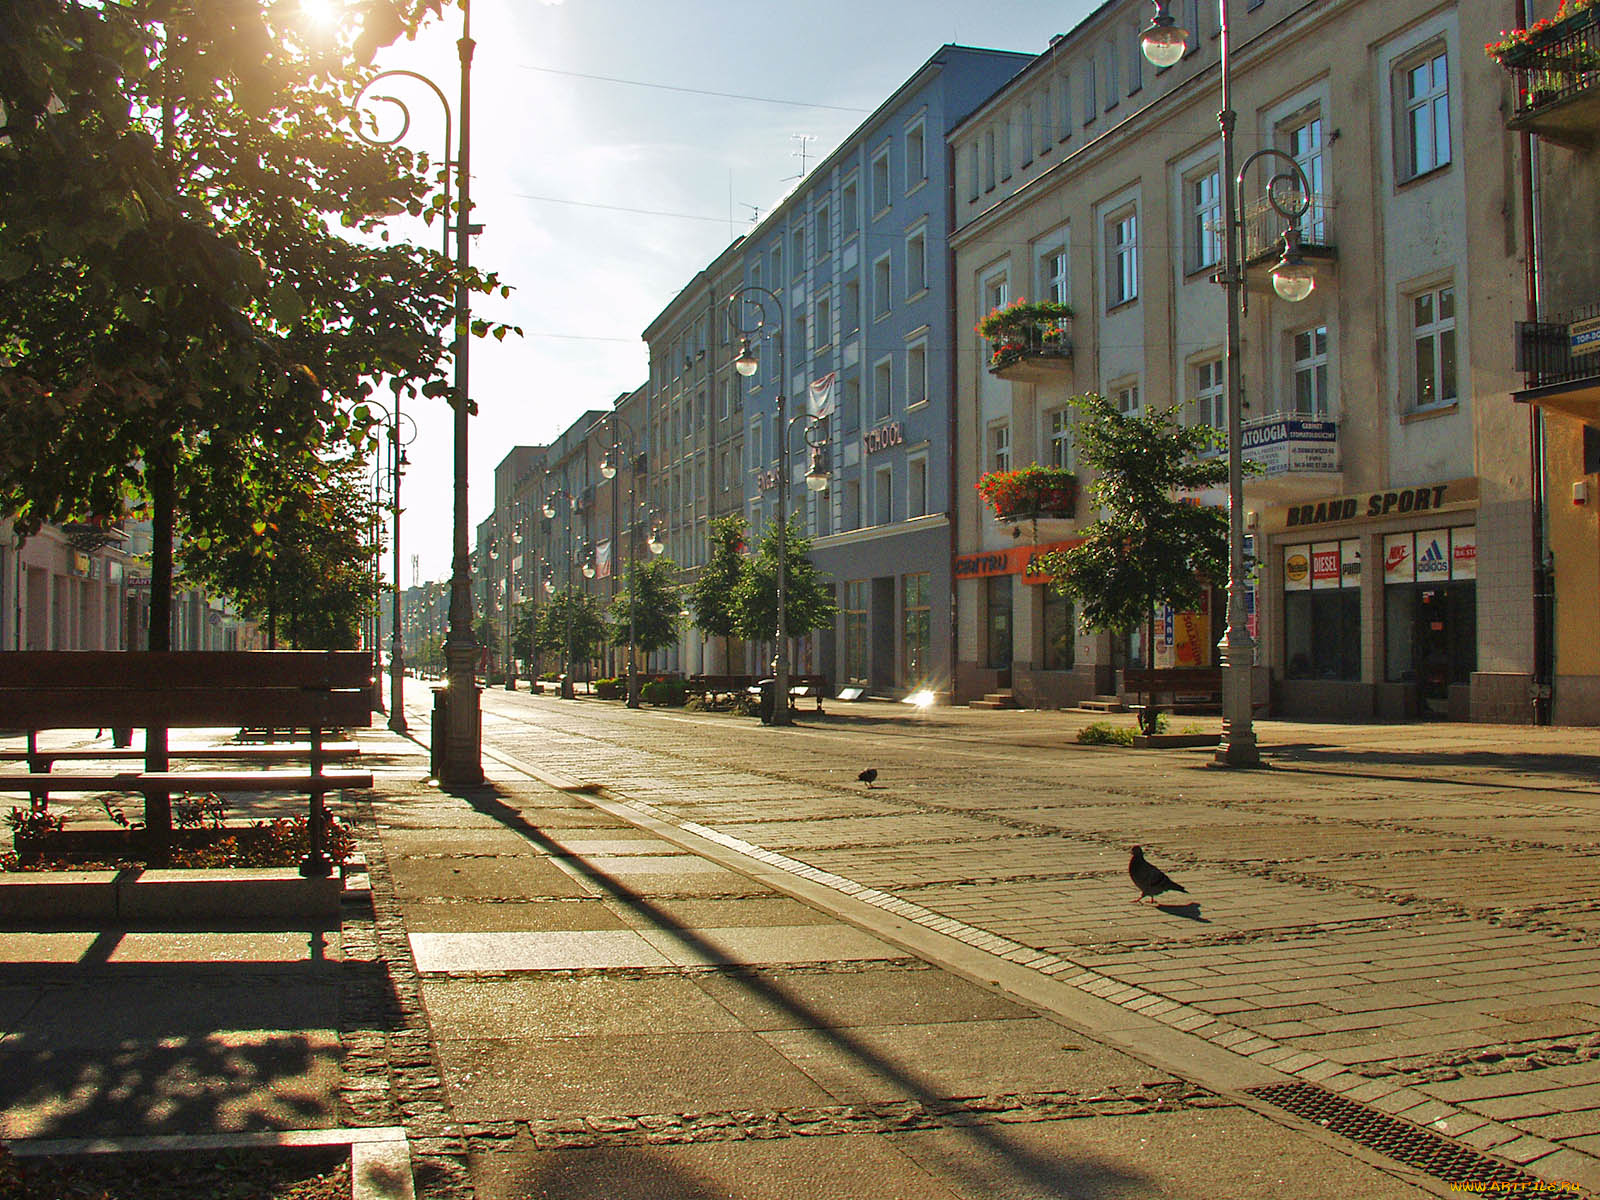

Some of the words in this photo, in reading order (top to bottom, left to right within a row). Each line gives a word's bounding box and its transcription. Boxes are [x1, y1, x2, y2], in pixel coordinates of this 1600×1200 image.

[863, 422, 903, 454] SCHOOL
[1241, 423, 1287, 447] ATOLOGIA
[1286, 498, 1358, 528] BRAND
[1367, 485, 1448, 518] SPORT
[1388, 545, 1408, 560] NIKE
[1313, 555, 1338, 573] DIESEL
[1417, 561, 1448, 573] adidas
